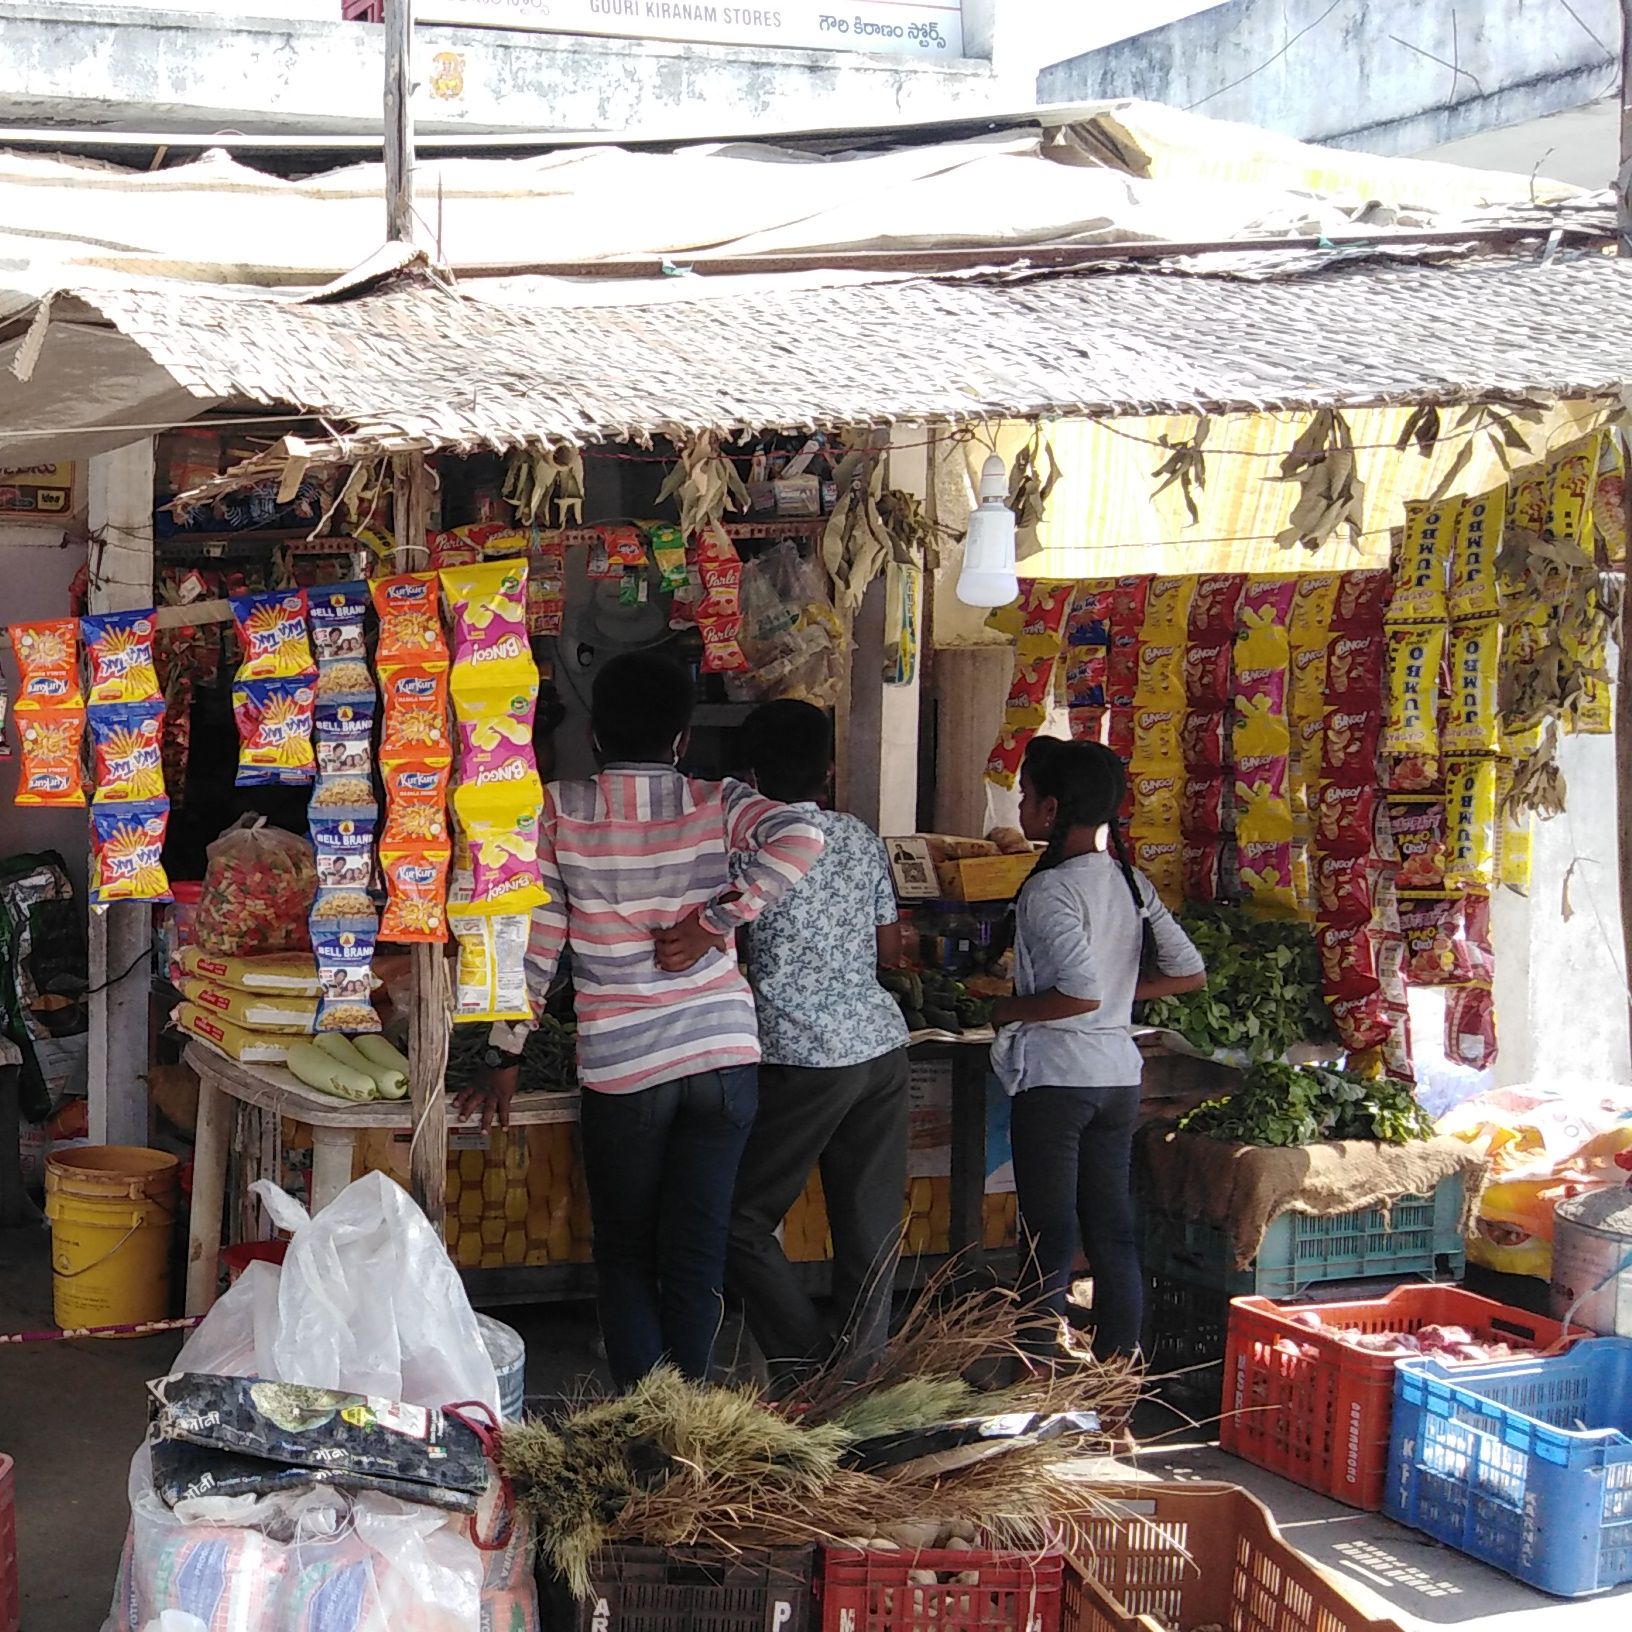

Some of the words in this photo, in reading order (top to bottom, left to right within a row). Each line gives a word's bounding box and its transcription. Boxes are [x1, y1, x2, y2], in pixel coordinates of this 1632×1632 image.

[643, 4, 717, 23] KIRANAM
[723, 10, 782, 28] STORES
[1467, 504, 1486, 582] JUMBO
[310, 608, 335, 617] BELL
[337, 605, 366, 616] BRAND
[1404, 646, 1424, 728] JUMBO
[1464, 641, 1479, 724] JUMBO
[316, 721, 341, 732] BELL
[342, 720, 373, 731] BRAND
[317, 834, 341, 846] BELL
[343, 834, 374, 845] BRAND
[318, 946, 342, 958] BELL
[344, 946, 375, 958] BRAND
